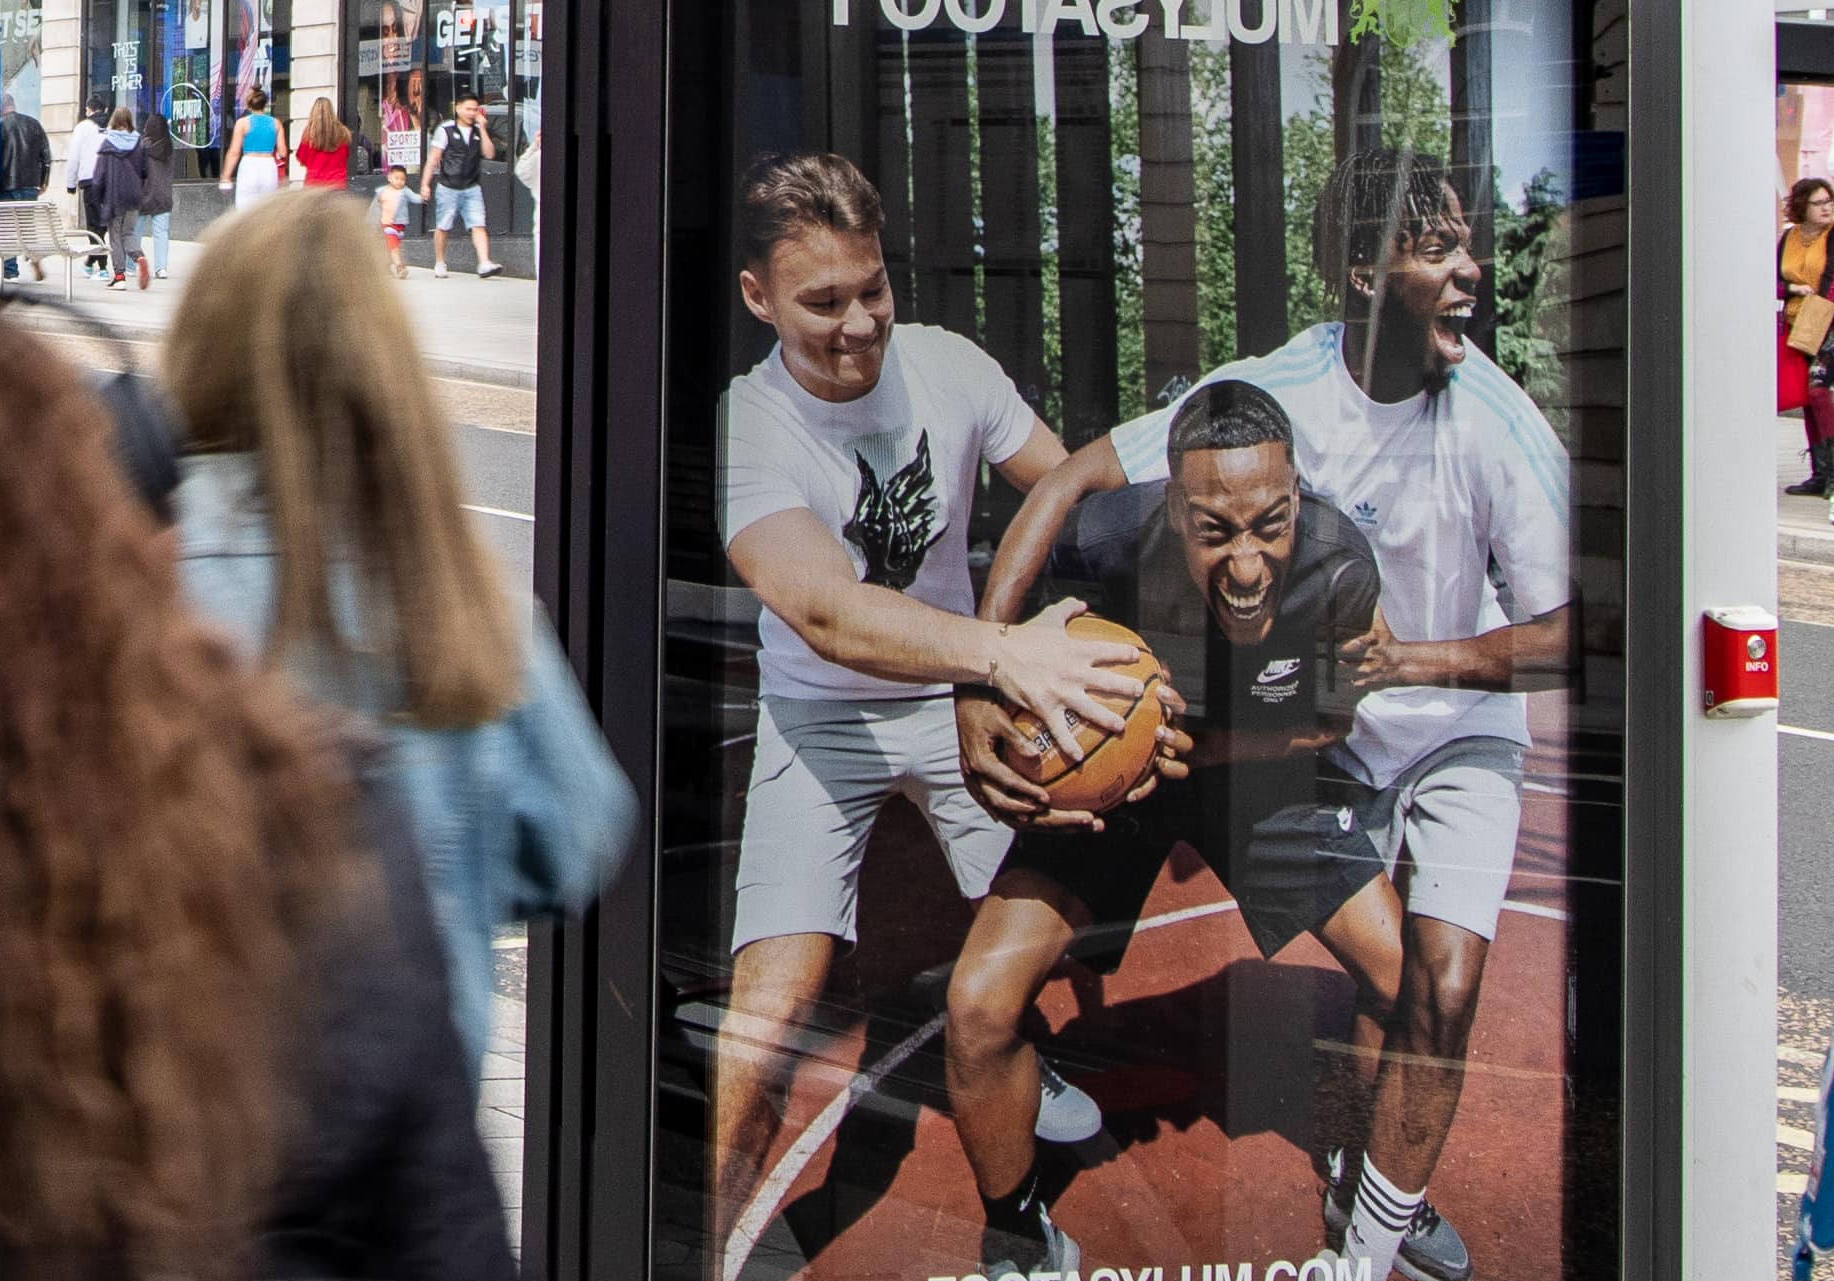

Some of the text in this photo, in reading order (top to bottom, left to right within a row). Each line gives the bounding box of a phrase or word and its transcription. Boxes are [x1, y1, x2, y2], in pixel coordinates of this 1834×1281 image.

[111, 41, 140, 58] THIS
[111, 74, 143, 91] POWER
[1745, 660, 1769, 672] INFO
